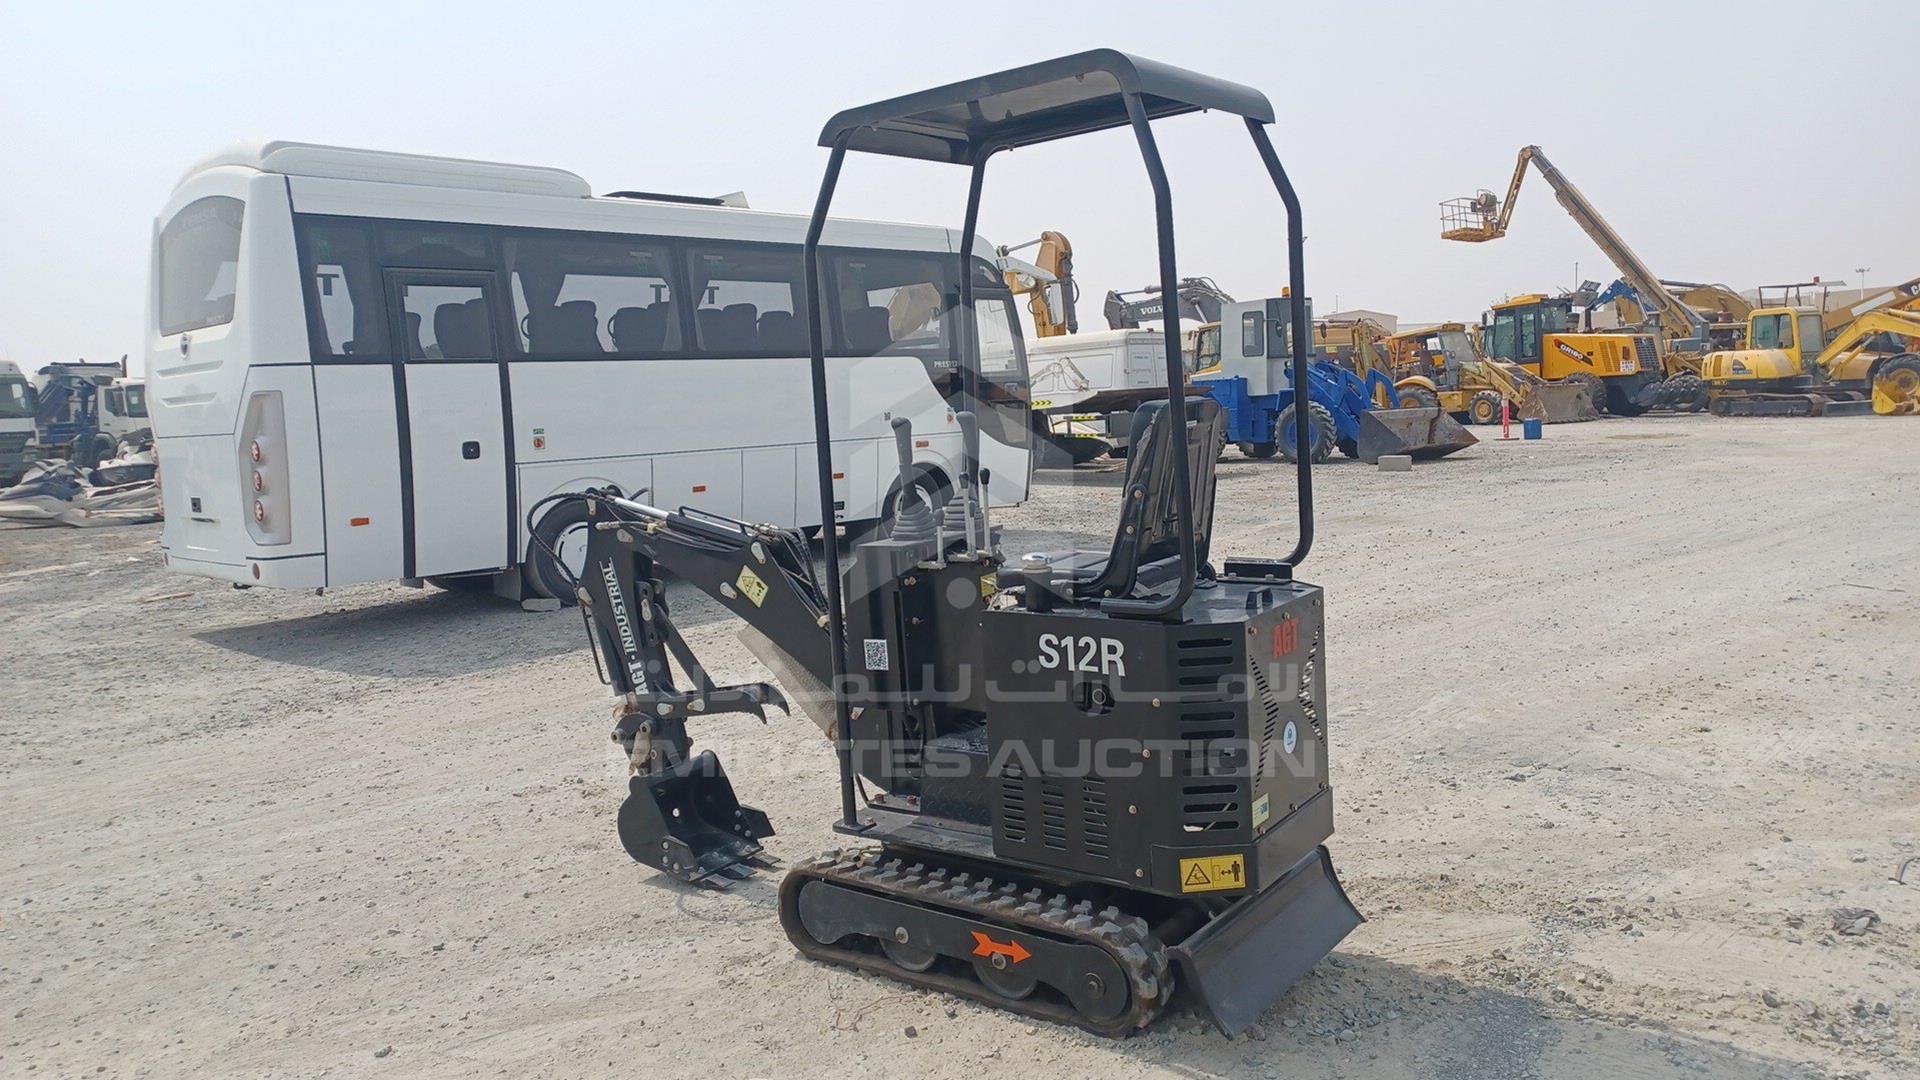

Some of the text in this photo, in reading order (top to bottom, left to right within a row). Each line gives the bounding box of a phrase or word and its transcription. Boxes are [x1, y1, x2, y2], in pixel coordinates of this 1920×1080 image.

[1140, 304, 1164, 316] VOLV
[601, 557, 650, 696] AGT INDUSTRIAL
[1273, 617, 1303, 658] AGT
[1038, 633, 1126, 677] S12R
